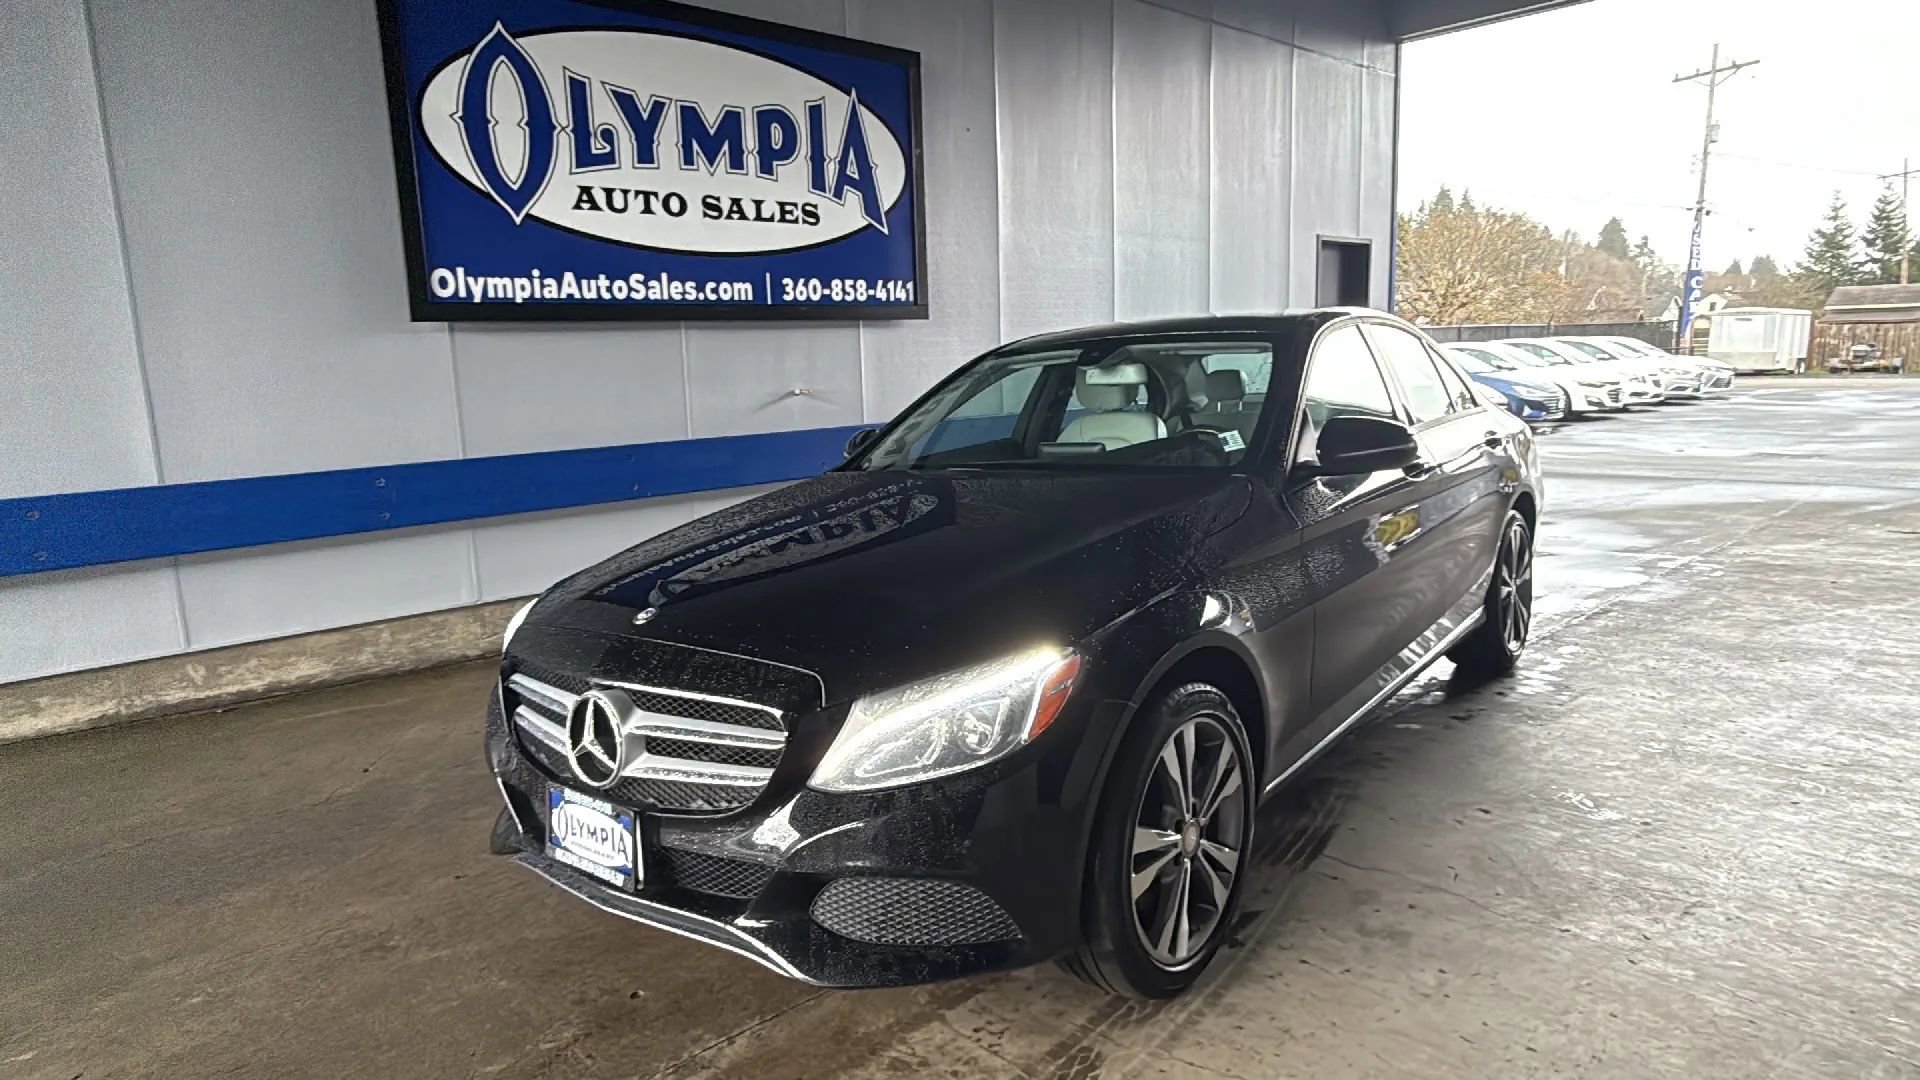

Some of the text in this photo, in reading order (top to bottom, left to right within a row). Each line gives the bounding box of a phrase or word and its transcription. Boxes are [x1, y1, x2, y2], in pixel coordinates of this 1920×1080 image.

[449, 20, 889, 236] OLYMPIA
[571, 185, 821, 227] AUTO SALES
[430, 267, 915, 304] OlympiaAutoSales.com 360-858-4141
[557, 801, 630, 863] OLYMPIA
